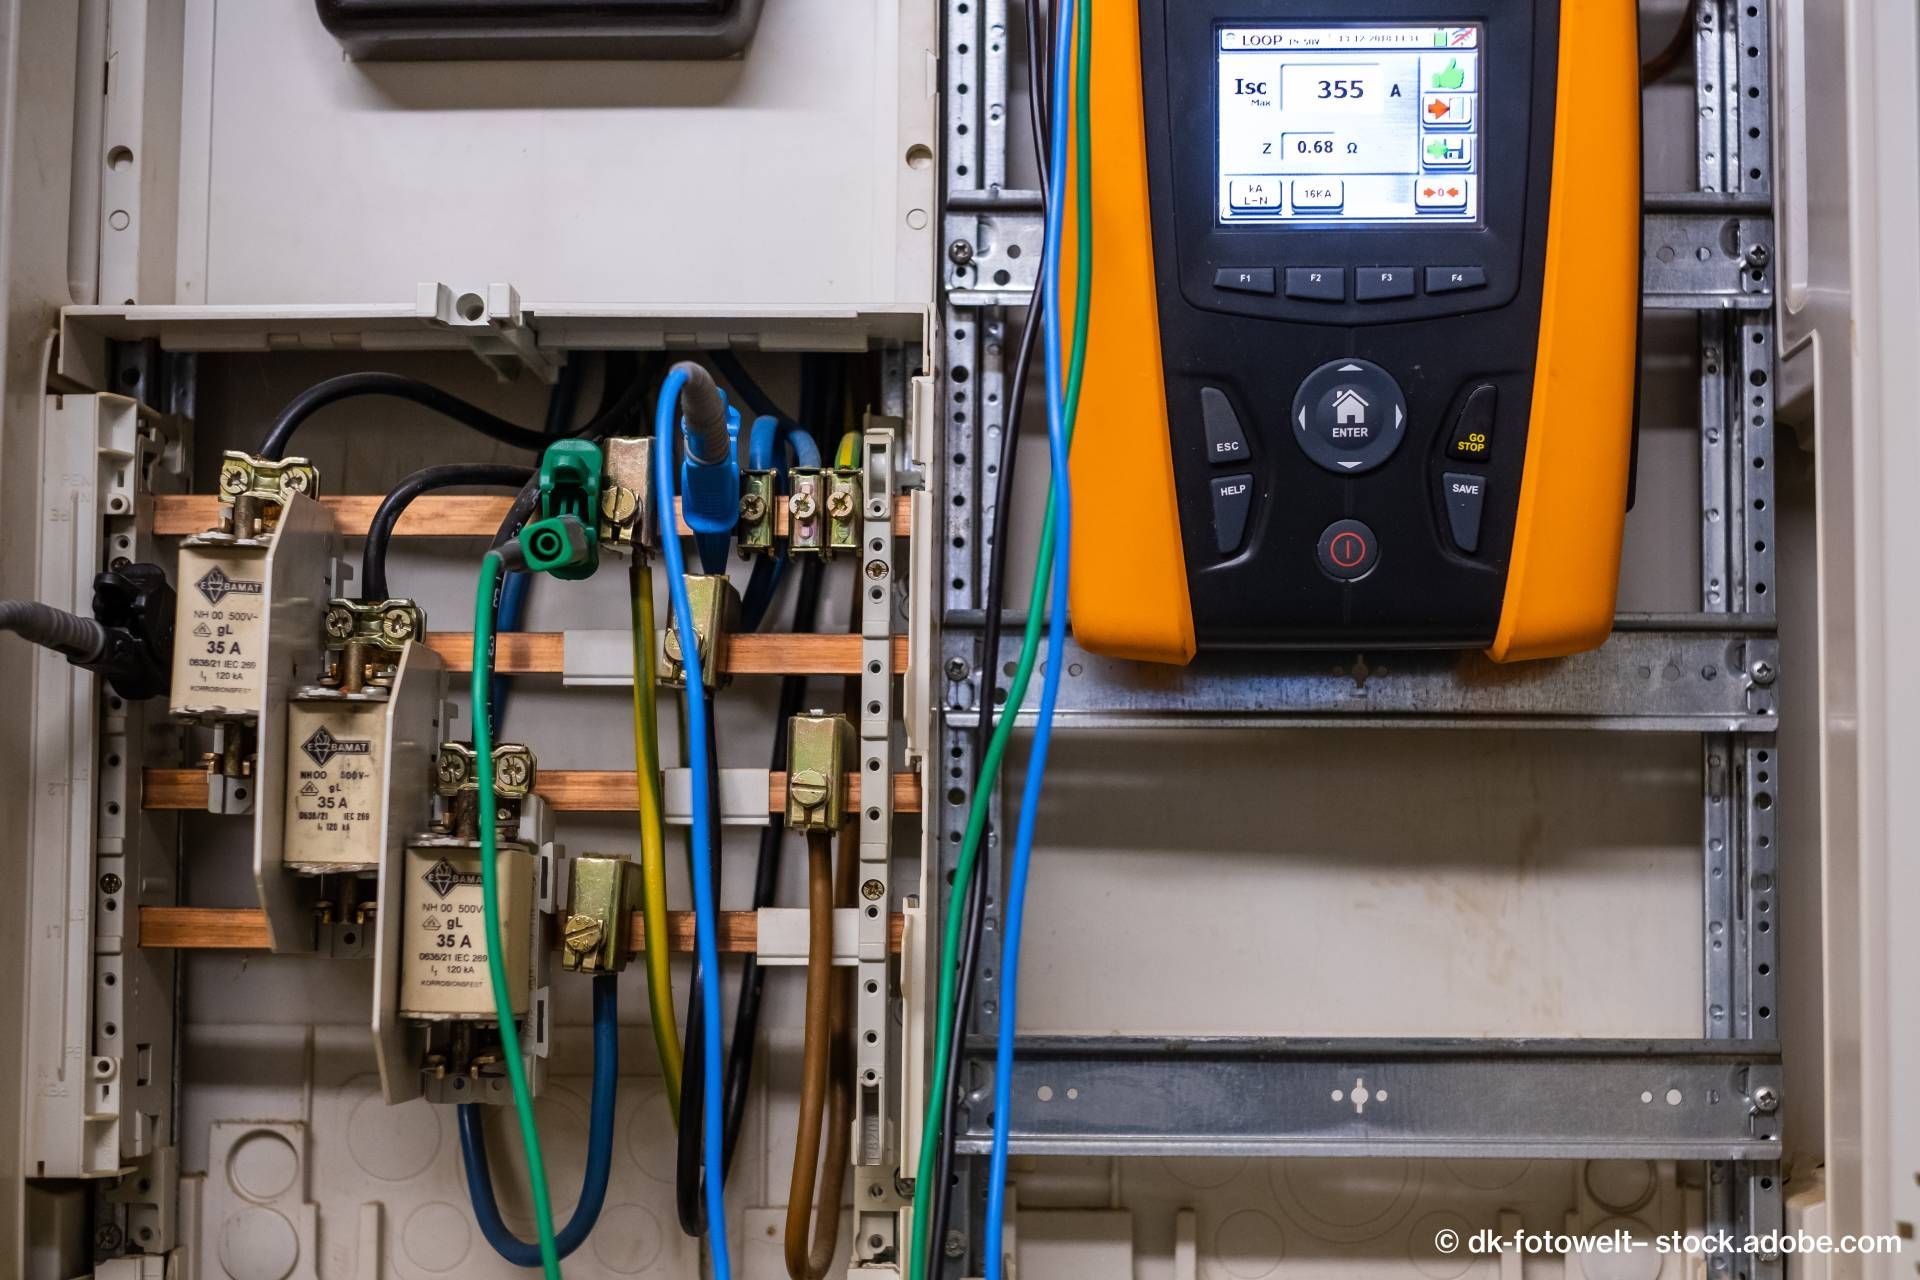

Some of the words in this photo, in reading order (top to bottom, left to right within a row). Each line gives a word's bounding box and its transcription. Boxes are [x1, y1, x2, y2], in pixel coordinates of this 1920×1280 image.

[1242, 35, 1282, 46] LOOP
[1317, 80, 1364, 99] 355
[1390, 84, 1401, 98] A
[1297, 140, 1334, 154] 0.68
[1347, 142, 1358, 154] Ω
[1244, 196, 1268, 205] L-N
[1240, 274, 1251, 282] F1
[1310, 273, 1321, 282] F2
[1381, 273, 1392, 282] F3
[1451, 273, 1462, 282] F4
[1332, 427, 1368, 437] ENTER
[1469, 433, 1485, 442] GO
[1216, 441, 1239, 452] ESC
[1458, 441, 1484, 452] STOP
[1220, 484, 1246, 496] HELP
[1452, 483, 1479, 494] SAVE
[211, 611, 224, 620] 00
[217, 624, 233, 637] gL
[207, 641, 225, 654] 35
[229, 642, 241, 655] A
[224, 660, 239, 669] IEC
[216, 671, 231, 680] 120
[232, 672, 244, 680] kA
[328, 783, 342, 794] gL
[317, 796, 335, 809] 35
[338, 797, 348, 809] A
[344, 812, 355, 821] IEC
[326, 823, 338, 831] 120
[342, 823, 350, 831] kA
[452, 873, 484, 883] BAMA
[422, 903, 438, 912] NH
[441, 903, 453, 913] 00
[446, 916, 463, 930] gL
[436, 934, 456, 948] 35
[460, 935, 472, 948] A
[454, 953, 470, 962] IEC
[447, 965, 462, 974] 120
[463, 966, 475, 974] kA
